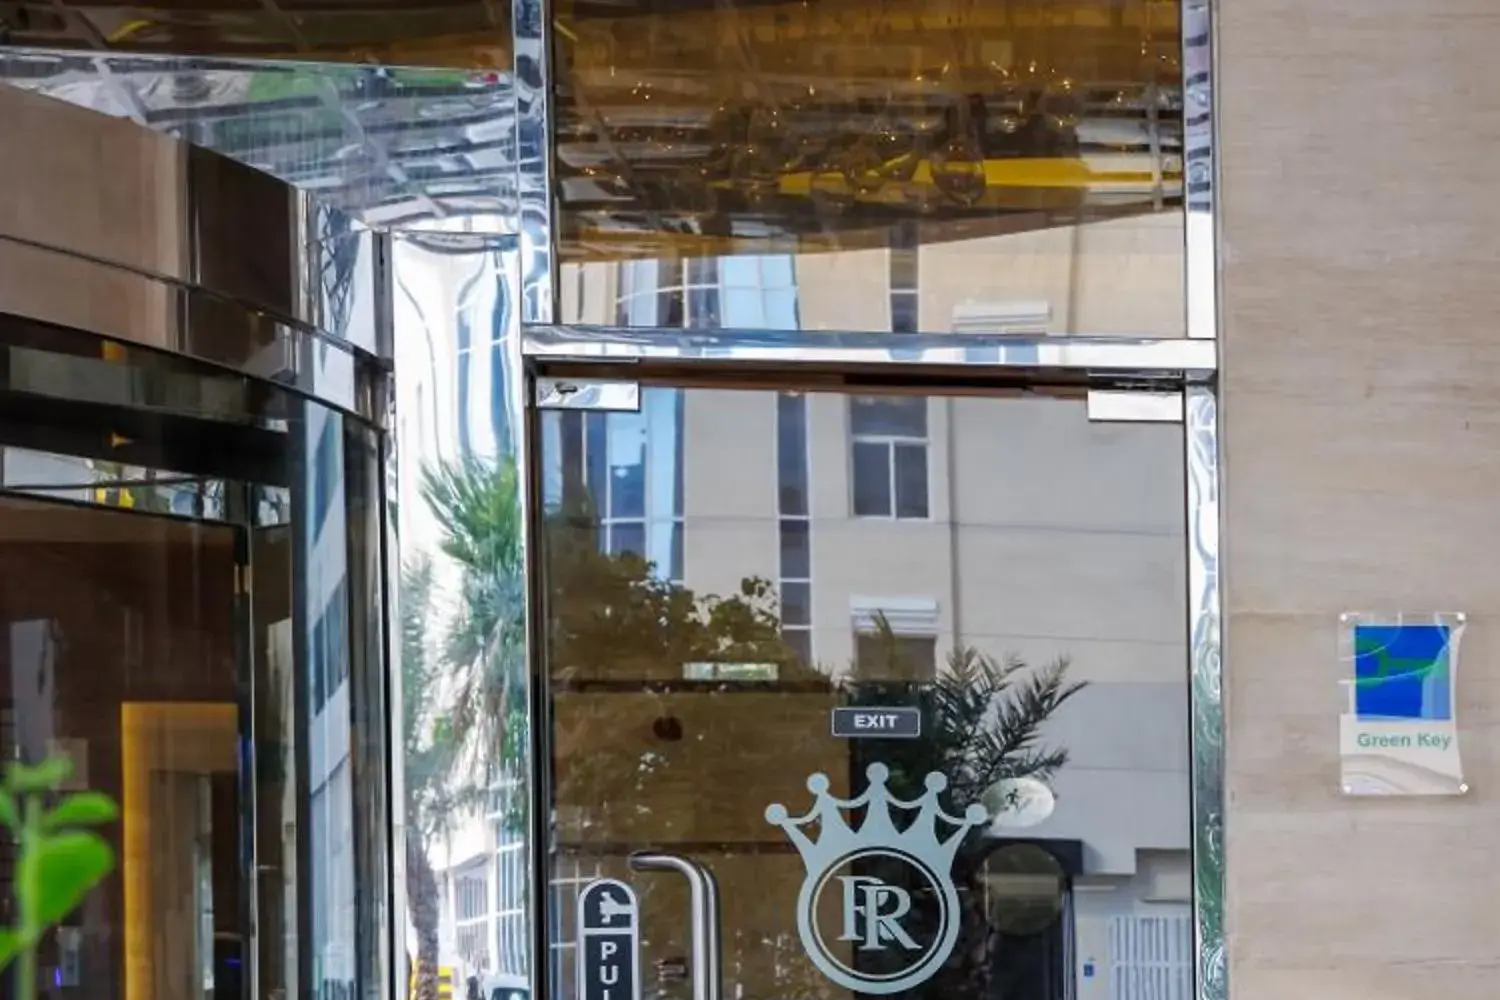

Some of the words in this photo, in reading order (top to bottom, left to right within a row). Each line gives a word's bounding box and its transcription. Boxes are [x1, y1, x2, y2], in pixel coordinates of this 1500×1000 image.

[853, 714, 899, 729] EXIT
[1357, 732, 1412, 748] Green
[1417, 732, 1453, 751] Key
